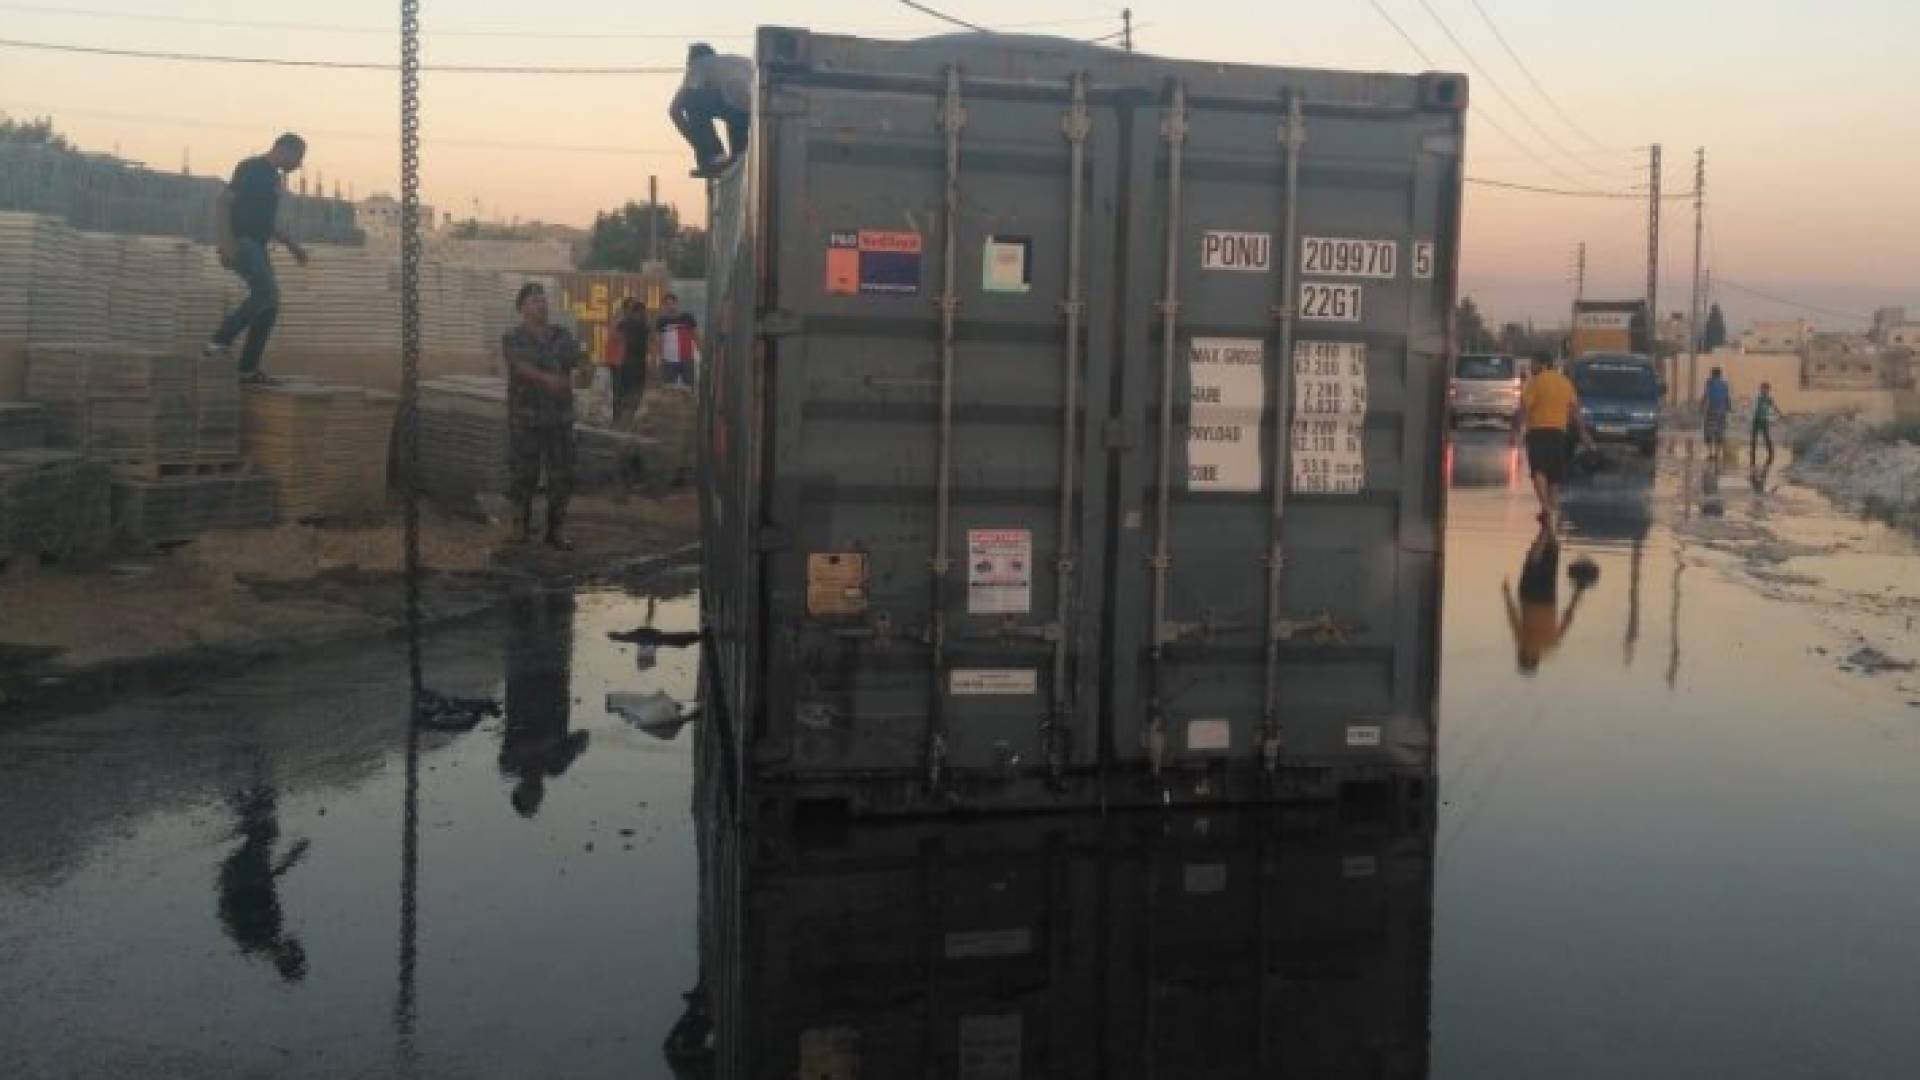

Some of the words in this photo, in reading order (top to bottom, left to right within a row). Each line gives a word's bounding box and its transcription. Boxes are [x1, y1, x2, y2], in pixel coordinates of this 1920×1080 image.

[1205, 234, 1268, 267] PONU
[1305, 239, 1393, 274] 209970
[1416, 245, 1430, 274] 5
[1303, 286, 1360, 317] 22G1
